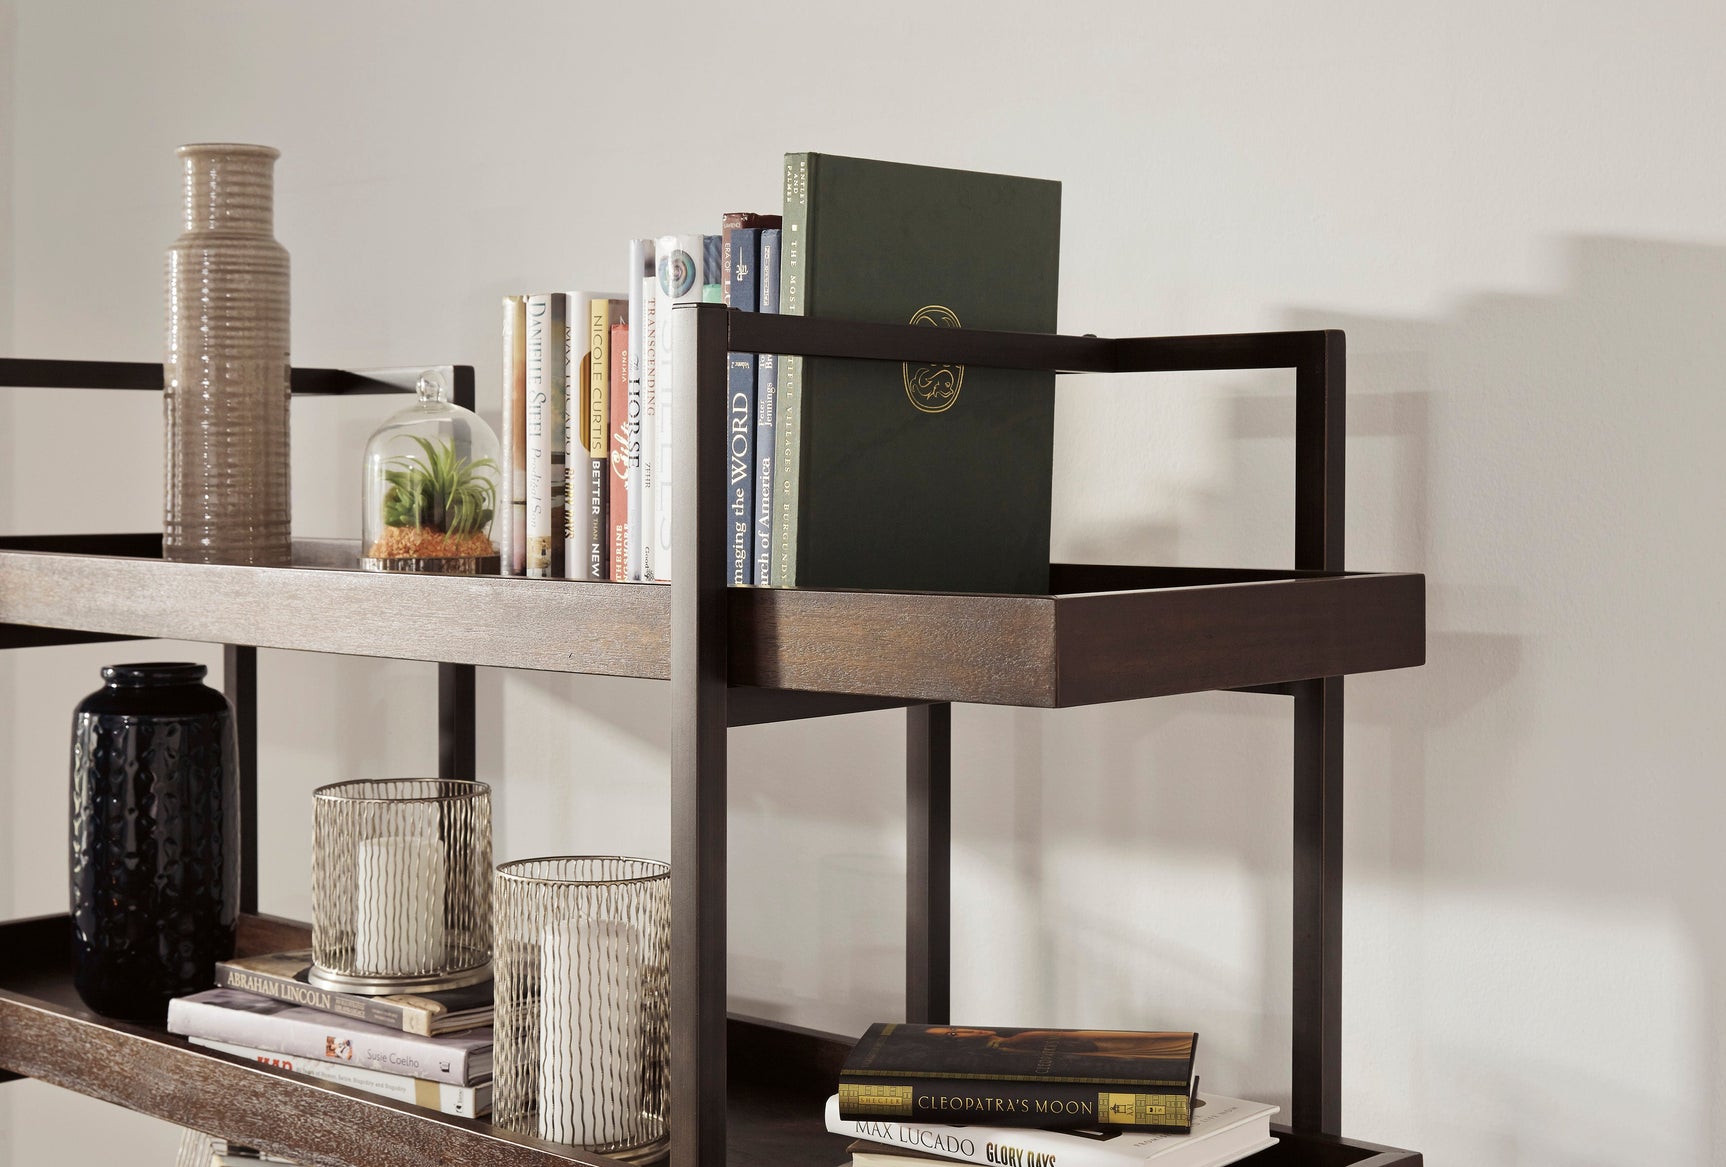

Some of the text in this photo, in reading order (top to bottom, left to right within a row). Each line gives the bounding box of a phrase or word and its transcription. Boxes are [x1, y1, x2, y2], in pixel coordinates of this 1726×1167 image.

[789, 275, 797, 312] MOST
[528, 302, 546, 439] DANIELLE STEEL
[647, 297, 656, 416] TRANSCENDING
[591, 315, 603, 450] NICOLE CURTIS
[628, 378, 640, 468] HORSE
[765, 382, 776, 427] Jennings
[731, 392, 748, 486] WORD
[784, 407, 793, 472] VILLAGES
[530, 447, 542, 528] Prodigal Son
[591, 460, 601, 515] BETTER
[732, 488, 744, 516] the
[759, 457, 772, 528] America
[783, 480, 791, 496] OF
[591, 543, 600, 577] NEW
[758, 530, 770, 549] of
[227, 971, 279, 997] ABRAHAM
[281, 983, 331, 1010] LINCOLN
[366, 1048, 420, 1069] Susie Coelho
[918, 1095, 1092, 1115] CLEOPATRA'S MOON
[855, 1121, 975, 1157] MAX LUCADO
[986, 1141, 1024, 1167] GLORY
